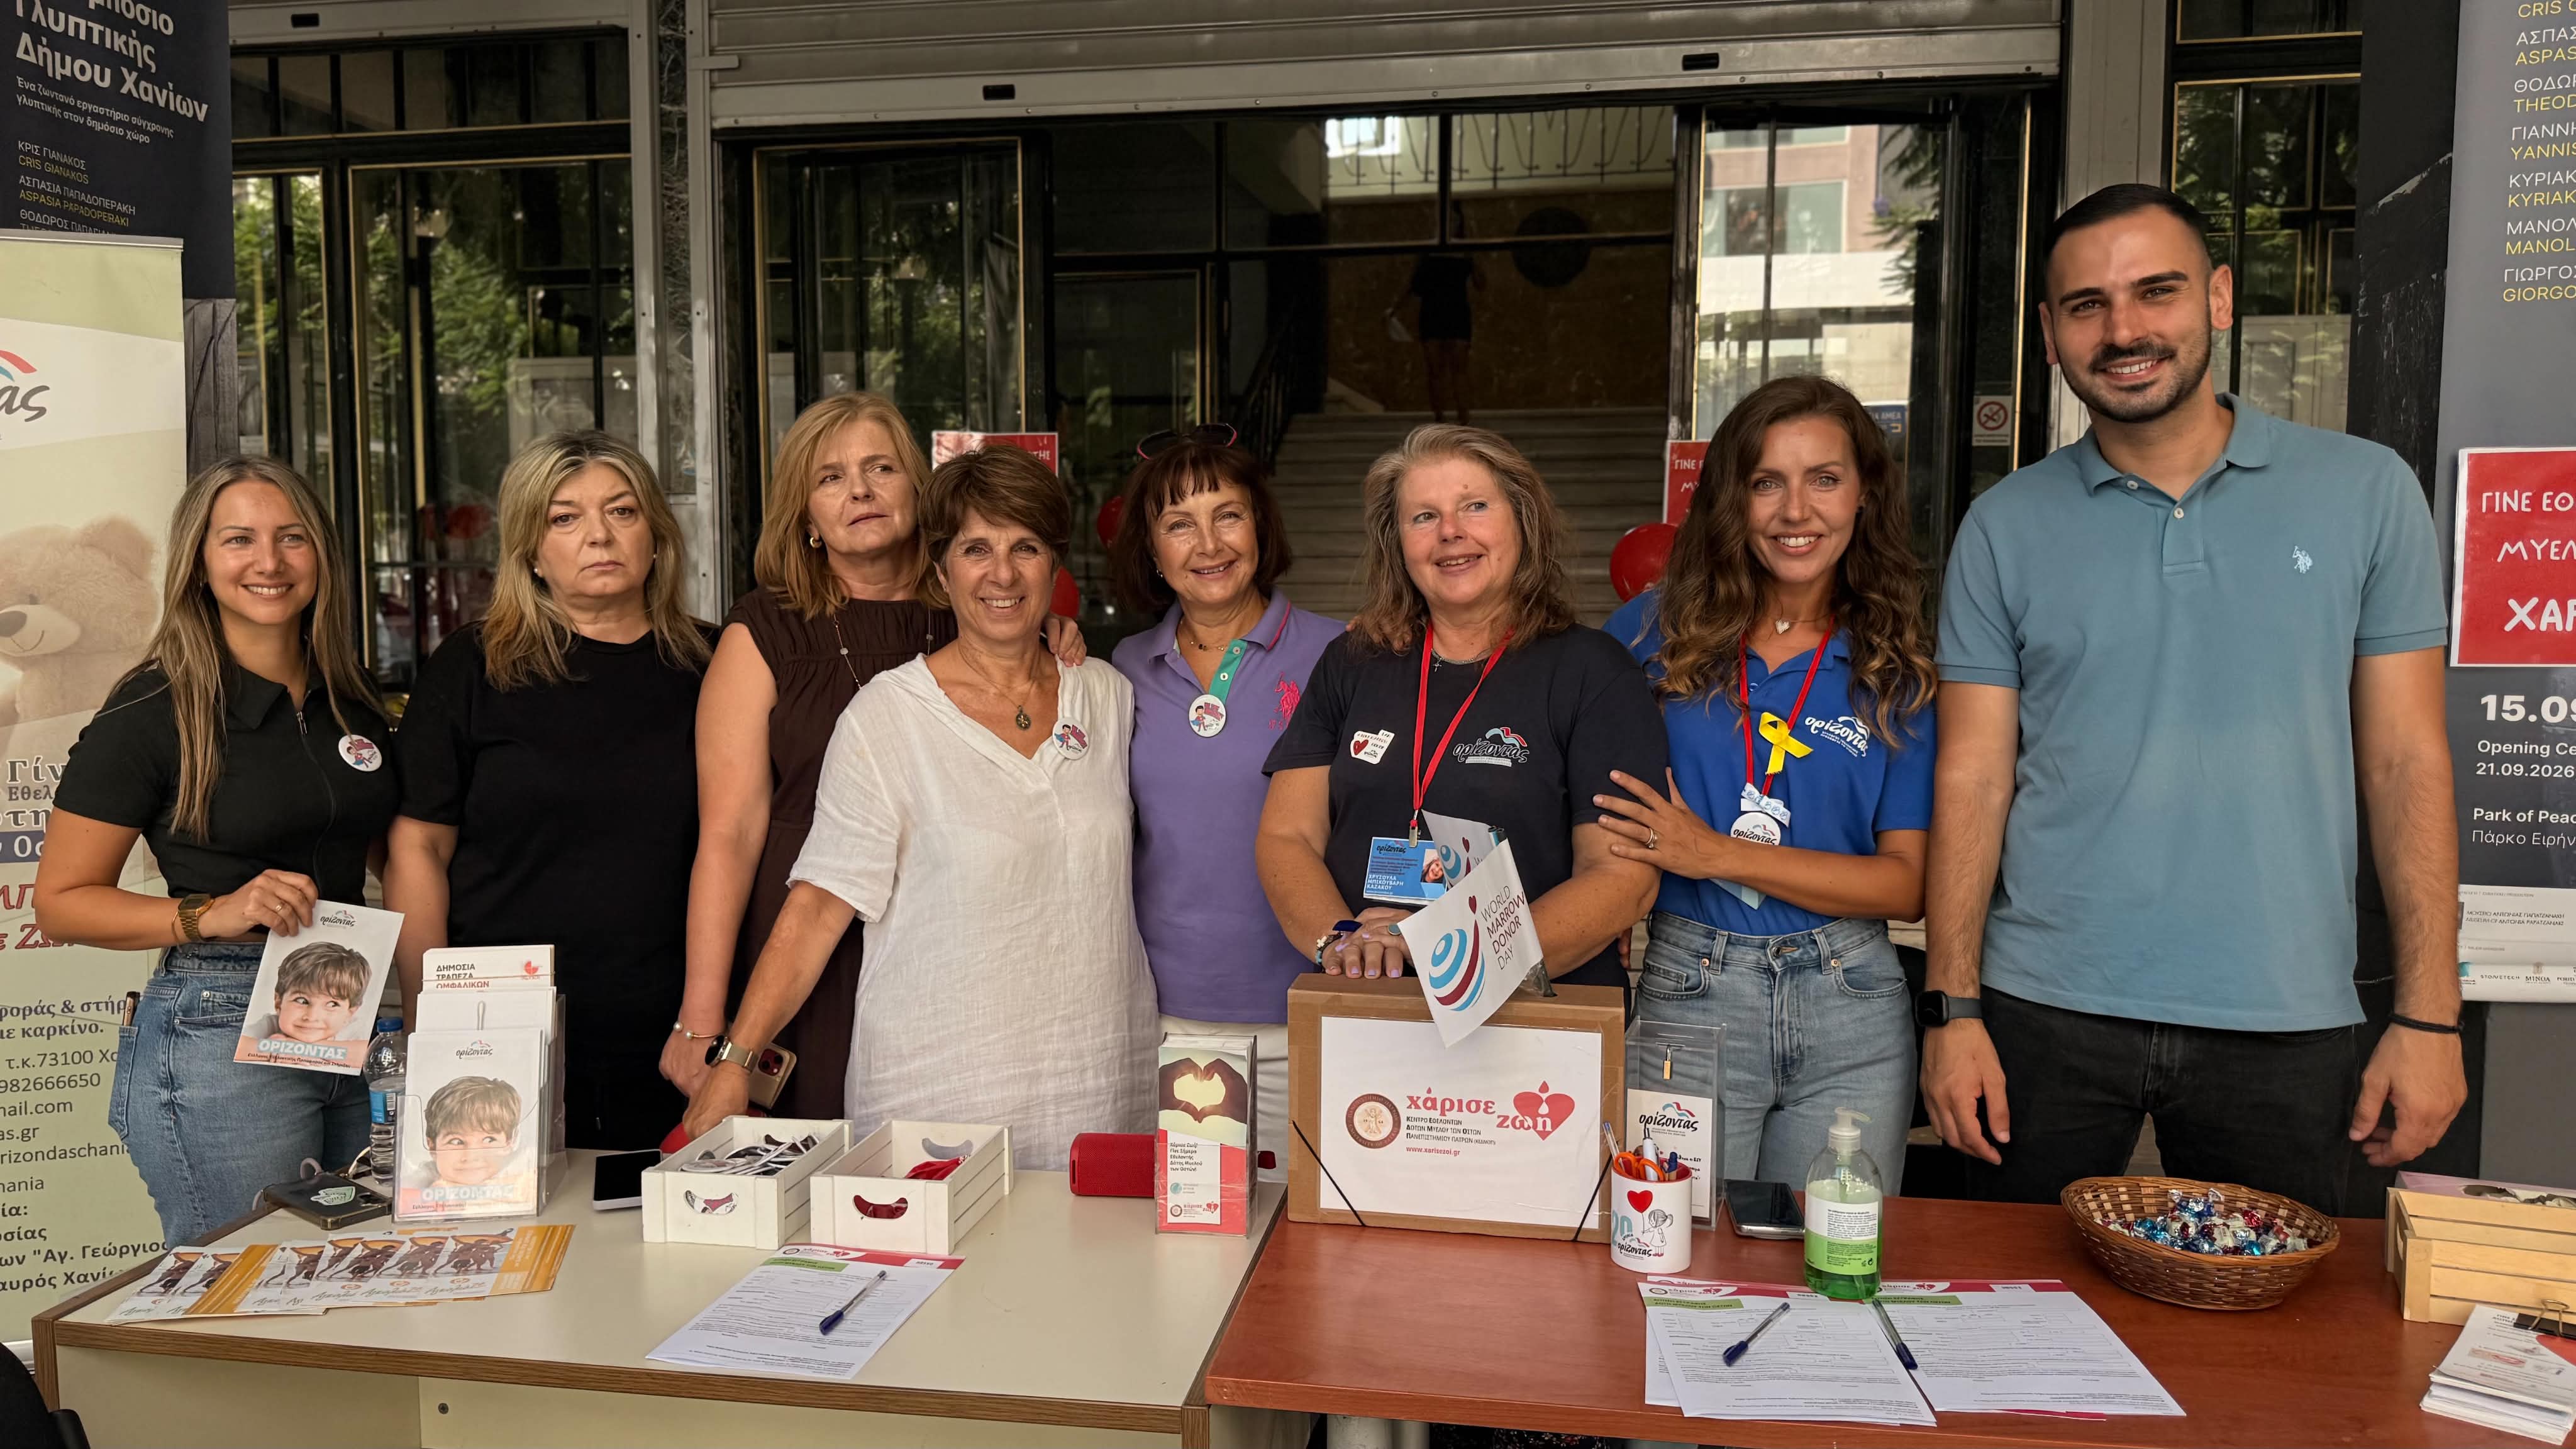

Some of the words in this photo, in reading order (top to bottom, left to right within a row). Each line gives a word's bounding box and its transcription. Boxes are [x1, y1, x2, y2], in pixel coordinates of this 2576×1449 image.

[2518, 1, 2562, 18] CRIS
[16, 32, 111, 89] Δήμου
[120, 66, 208, 122] Χανίων
[16, 75, 36, 92] Ένα
[38, 83, 75, 106] ζωντανό
[77, 100, 130, 123] εργαστήριο
[131, 115, 174, 138] σύγχρονης
[16, 94, 62, 118] γλυπτικής
[63, 110, 84, 125] στον
[86, 116, 125, 136] δημόσιο
[126, 129, 150, 143] χώρο
[18, 140, 41, 156] ΚΡΙΣ
[43, 147, 86, 170] ΓΙΑΝΑΚΟΣ
[19, 155, 42, 170] CRIS
[44, 162, 89, 184] GIANAKOS
[2509, 170, 2576, 188] ΚΥΡΙΑΚ
[19, 175, 62, 193] ΑΣΠΑΣΙΑ
[63, 186, 136, 216] ΠΑΠΑΔΟΠΕΡΑΚΗ
[2508, 190, 2576, 208] KYRIAK
[19, 190, 62, 208] ASPASIA
[63, 200, 129, 226] PAPADOPERAKI
[19, 209, 70, 230] ΘΟΔΩΡΟΣ
[2506, 238, 2576, 255] MANOL
[2504, 265, 2576, 282] ΓΙΩΡΓΟ
[2503, 285, 2576, 302] GIORGO
[1675, 459, 1696, 470] ΓΙΝΕ
[2482, 490, 2533, 513] ΓΙΝΕ
[2481, 694, 2576, 723] 15.0
[1805, 717, 1868, 757] ορίζοντας
[1453, 738, 1530, 763] ορίζοντας
[2477, 740, 2550, 758] Opening
[2473, 808, 2511, 821] Park
[2516, 810, 2534, 823] of
[2472, 830, 2526, 847] Πάρκο
[1480, 886, 1511, 922] WORLD
[1487, 891, 1525, 939] MARROW
[1492, 915, 1521, 954] DONOR
[1497, 944, 1514, 970] DAY
[436, 963, 475, 972] ΔΗΜΟΣΙΑ
[436, 972, 474, 980] ΤΡΑΠΕΖΑ
[61, 999, 75, 1013] &
[21, 1019, 104, 1040] καρκίνο.
[258, 1040, 347, 1060] ΟΡΙΖΟΝΤΑΣ
[456, 1048, 492, 1059] ορίζοντας
[1639, 1112, 1699, 1133] ορίζοντας
[1452, 1136, 1473, 1144] ΠΑΤΡΩΝ
[1406, 1146, 1460, 1157] www.xarisezoi.gr
[0, 1226, 47, 1241] σίας
[1618, 1242, 1653, 1257] ορίζοντας
